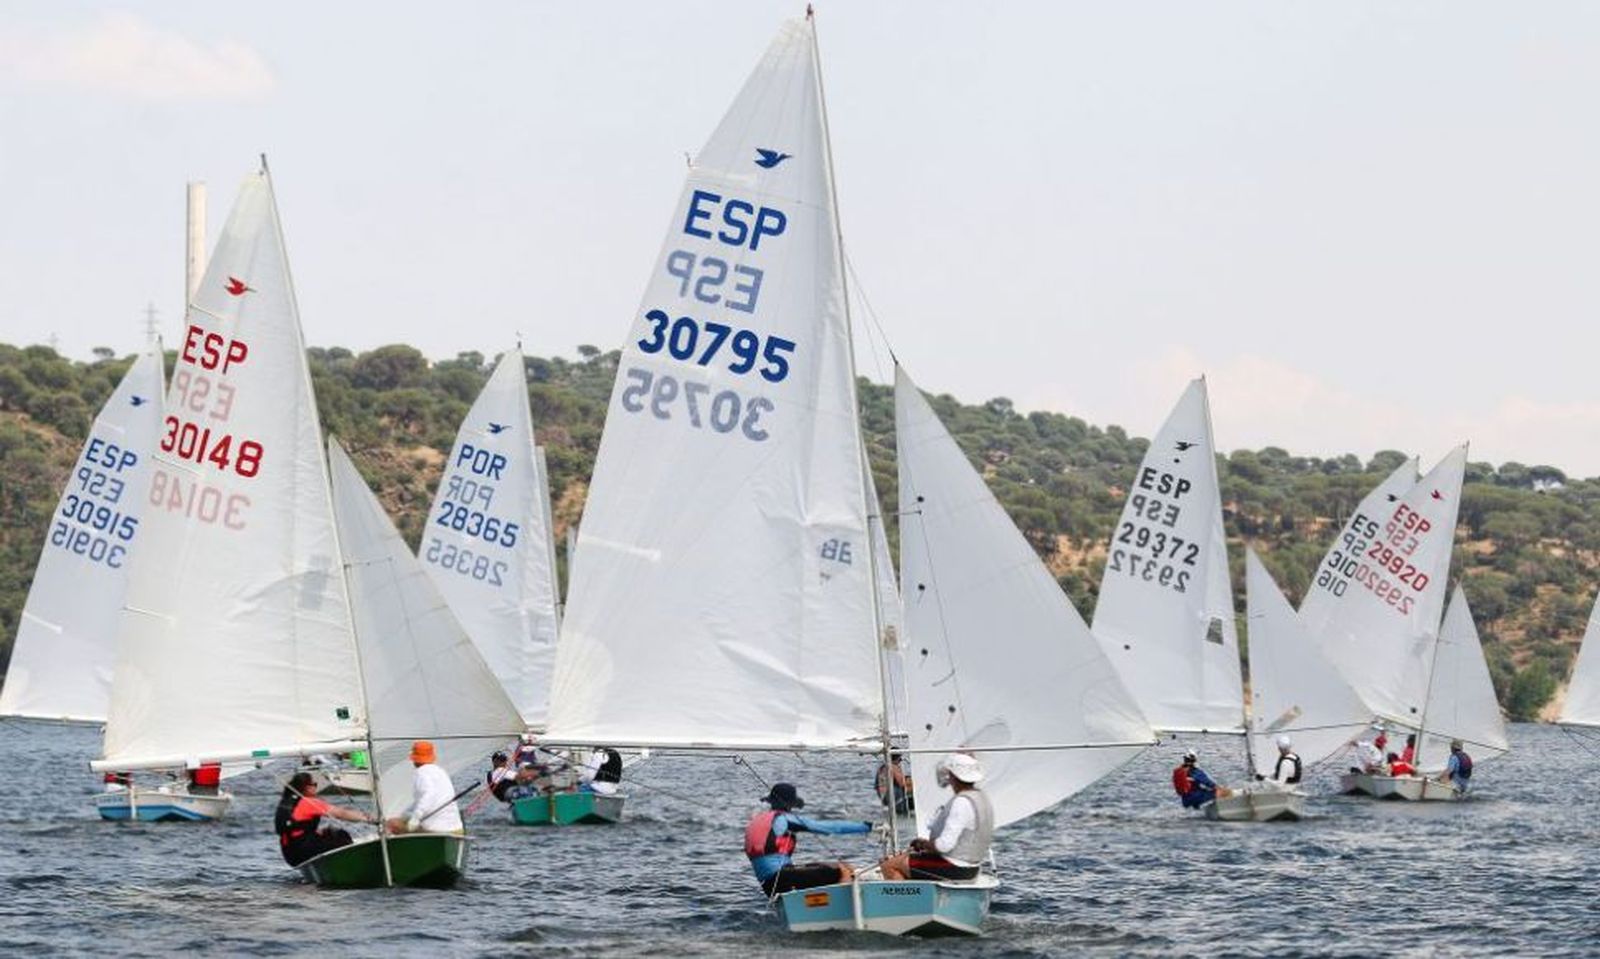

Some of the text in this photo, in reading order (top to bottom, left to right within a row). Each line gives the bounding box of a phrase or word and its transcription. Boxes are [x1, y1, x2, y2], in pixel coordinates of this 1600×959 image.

[683, 190, 787, 250] ESP
[181, 325, 248, 375] ESP
[638, 309, 796, 383] 30795
[85, 438, 138, 473] ESP
[160, 416, 264, 478] 30148
[456, 444, 507, 480] POR
[1139, 467, 1191, 499] ESP
[62, 495, 139, 540] 30915
[436, 501, 519, 548] 28365
[1351, 514, 1380, 539] ES
[1393, 503, 1431, 534] ESP
[1118, 522, 1200, 566] 29372
[1328, 551, 1359, 579] 310
[1368, 541, 1429, 592] 29920
